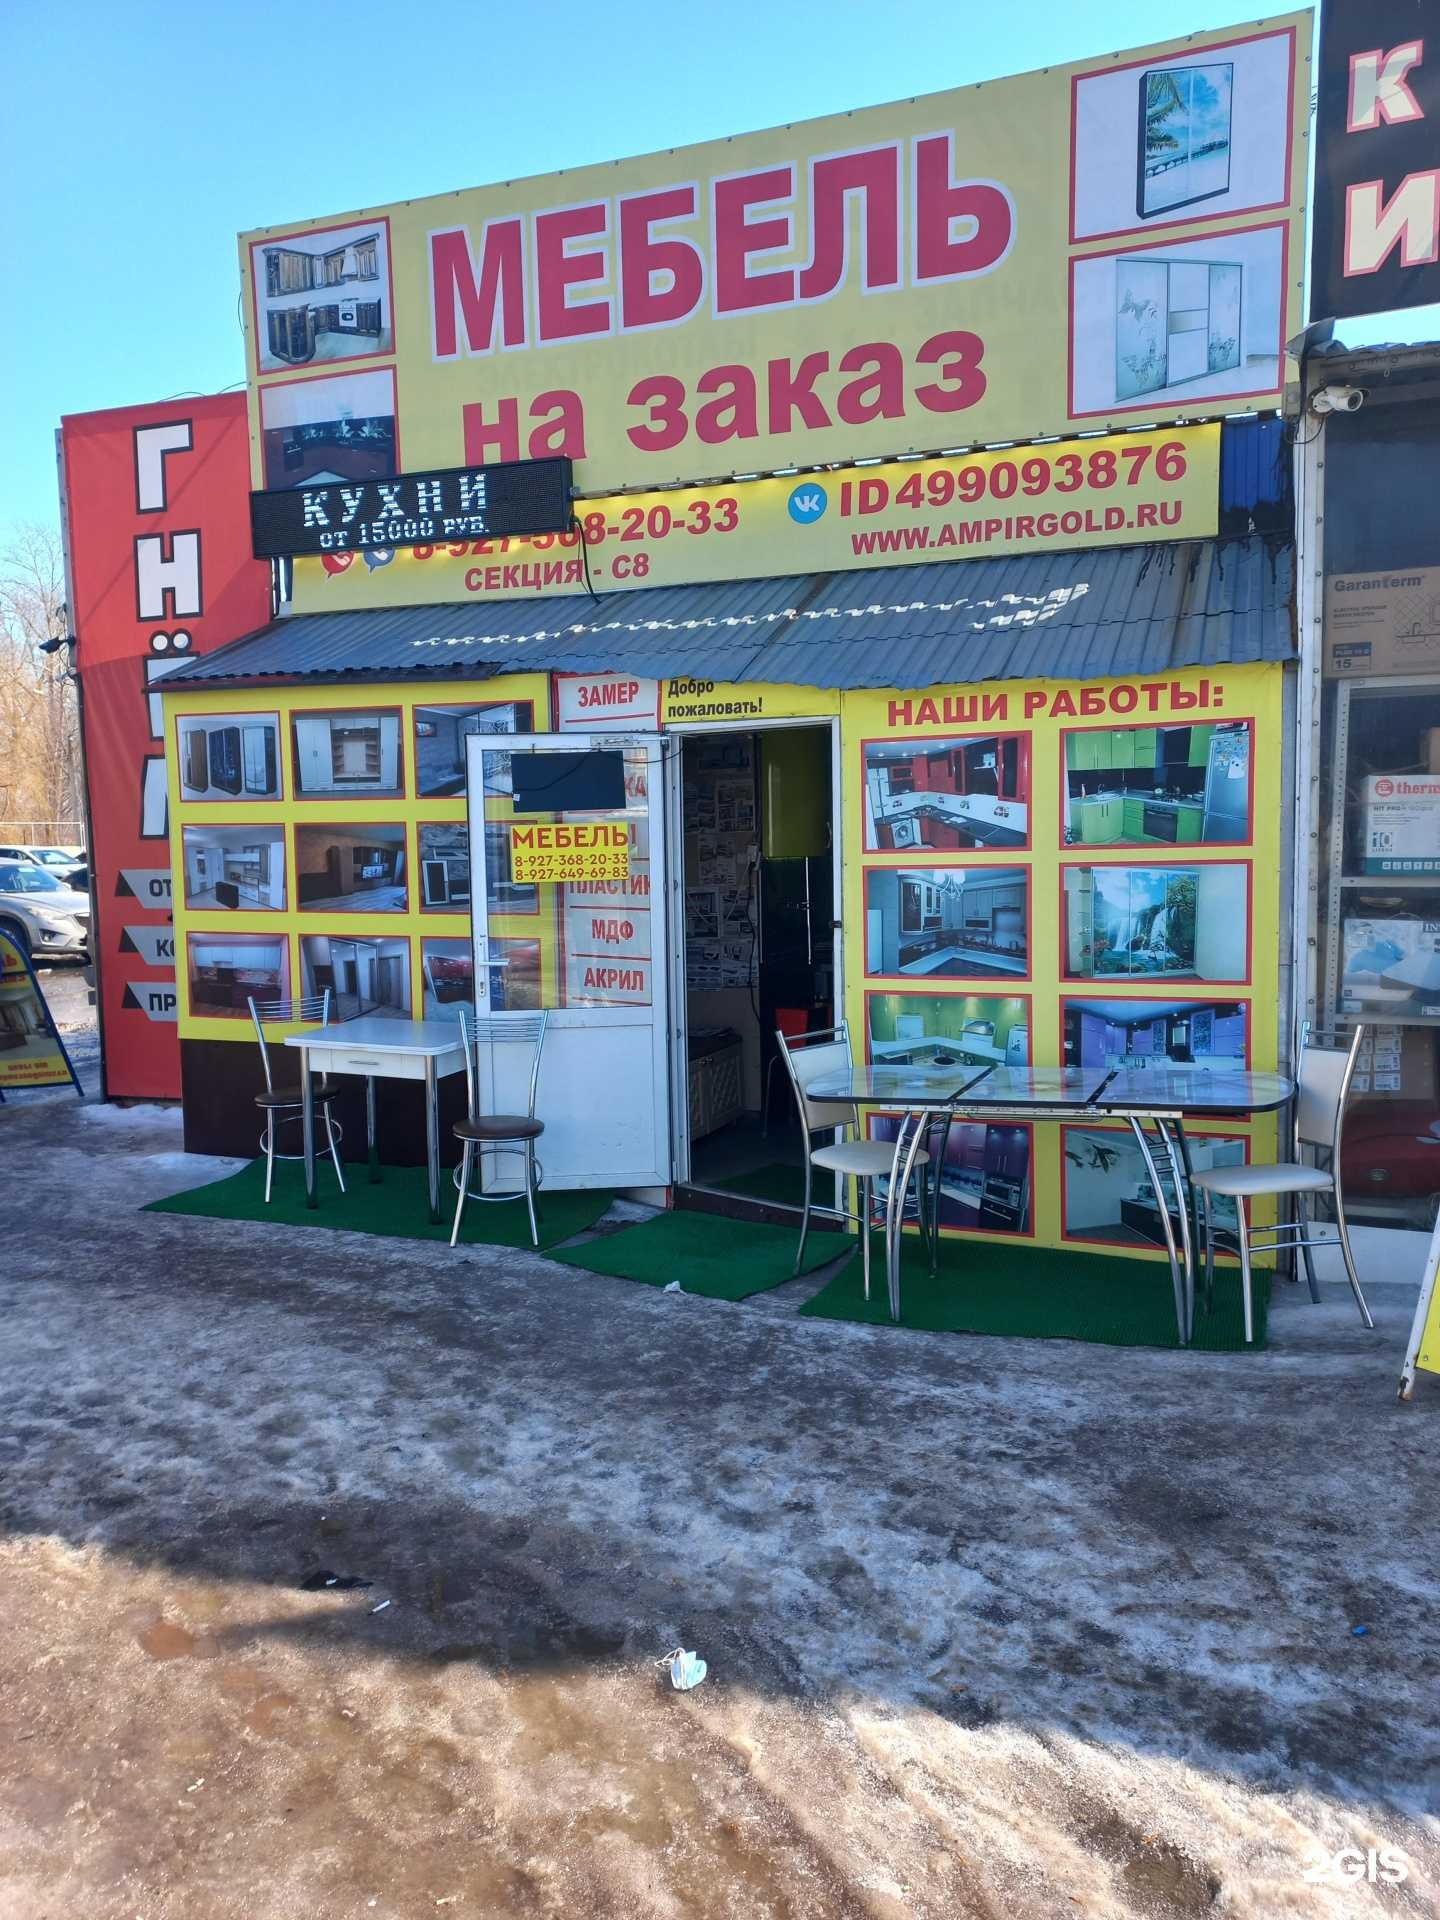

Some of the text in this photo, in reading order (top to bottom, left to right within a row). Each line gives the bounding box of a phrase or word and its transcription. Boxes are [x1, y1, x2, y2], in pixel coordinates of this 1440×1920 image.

[429, 133, 1014, 360] МЕБЕЛЬ
[462, 389, 587, 466] на
[626, 330, 988, 451] заказ
[302, 474, 487, 528] КУХНИ
[358, 518, 434, 545] 15000
[851, 500, 1183, 556] WWW.AMPIRGOLD.RU
[465, 557, 585, 591] СЕКЦИЯ
[1335, 658, 1352, 669] 15
[577, 682, 640, 708] ЗАМЕР
[667, 679, 714, 698] Добро
[667, 697, 763, 717] пожаловать!
[888, 679, 1224, 727] НАШИ РАБОТЫ:
[512, 825, 629, 849] МЕБЕЛЬ
[514, 853, 629, 867] 8-927-368-20-33
[514, 867, 629, 881] 8-927-649-69-83
[591, 919, 634, 945] МДФ
[584, 967, 644, 992] АКРИЛ
